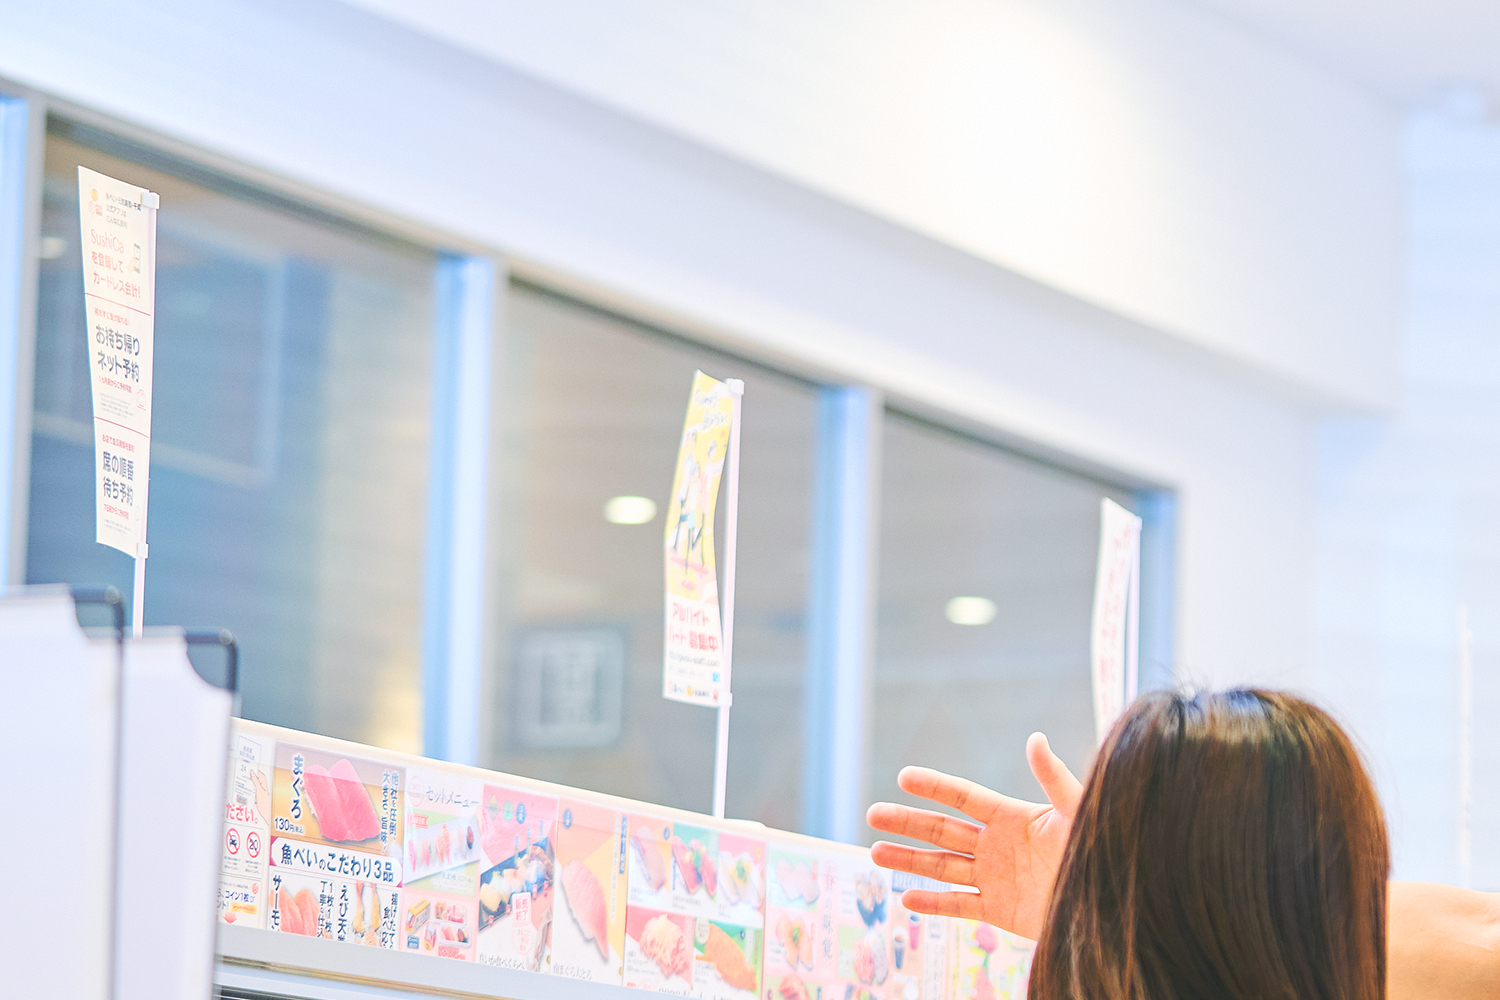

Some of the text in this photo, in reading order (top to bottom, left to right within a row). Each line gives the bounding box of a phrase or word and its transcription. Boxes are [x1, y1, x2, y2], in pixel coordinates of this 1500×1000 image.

[90, 228, 124, 253] SushiCa
[95, 323, 140, 357] お持ち帰り
[97, 349, 140, 383] ネット予約
[102, 450, 135, 481] 席の順番
[102, 475, 134, 507] 待ち予約
[291, 754, 305, 819] まぐろ
[426, 786, 480, 808] セットメニュー
[280, 842, 395, 883] 魚べいのこだわり3品
